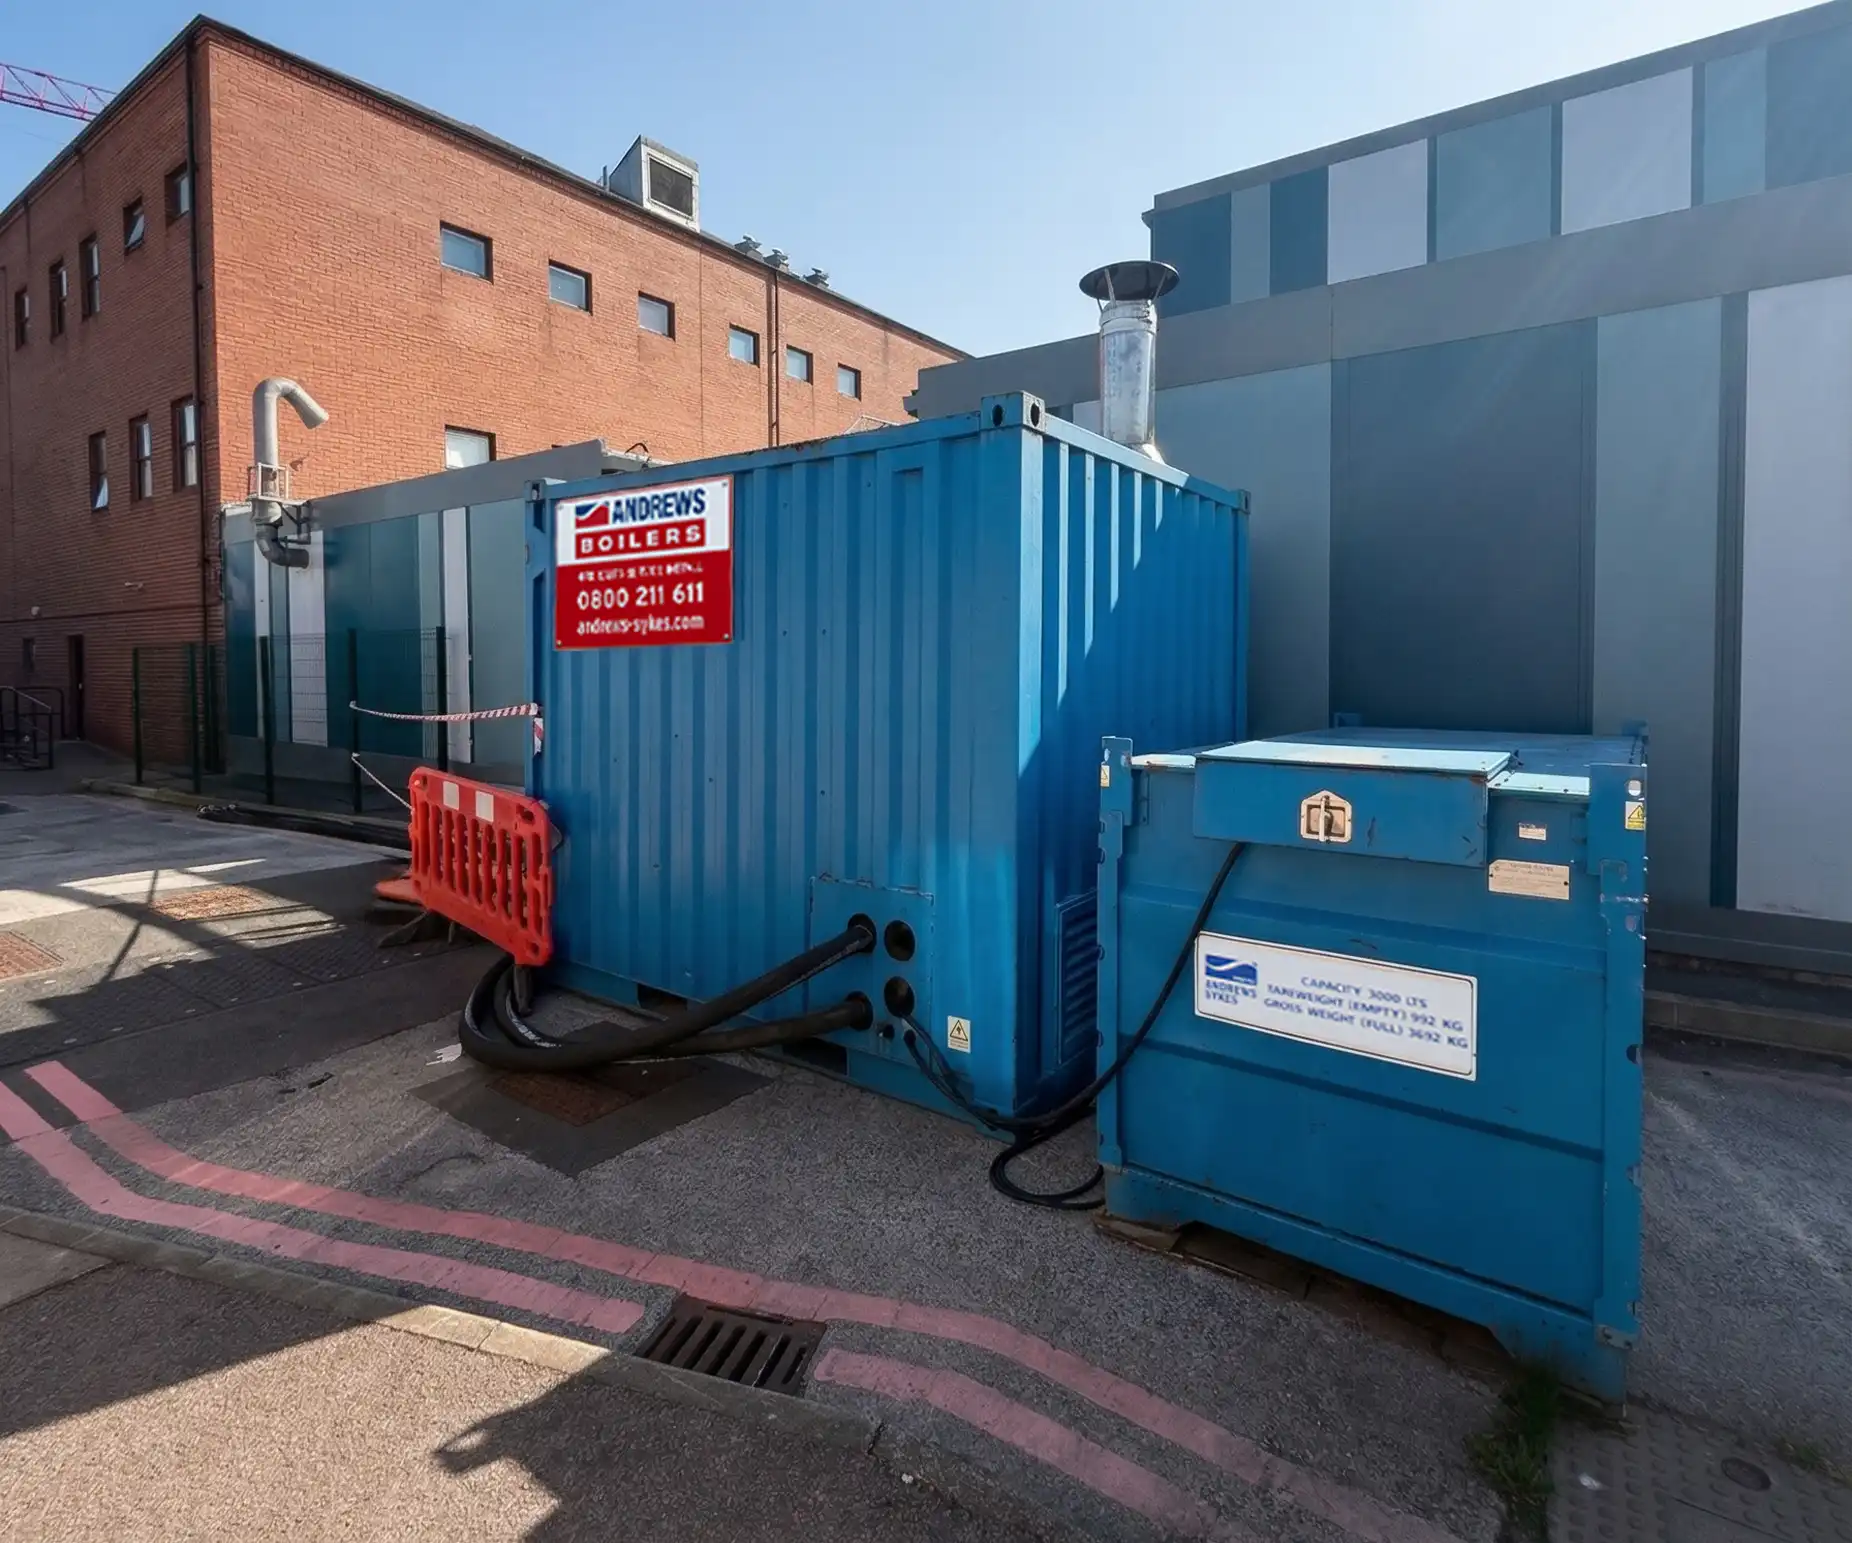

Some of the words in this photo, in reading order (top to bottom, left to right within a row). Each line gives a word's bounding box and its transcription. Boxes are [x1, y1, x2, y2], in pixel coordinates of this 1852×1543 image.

[612, 487, 706, 525] ANDREWS
[580, 524, 702, 554] BOILERS
[576, 588, 630, 611] 0800
[635, 585, 665, 607] 211
[672, 581, 704, 604] 611
[576, 614, 705, 636] andrews-sykes.com
[1300, 976, 1362, 996] CAPACITY
[1368, 988, 1402, 1004] 3000
[1406, 996, 1428, 1010] LTS
[1307, 1006, 1356, 1026] WEIGHT
[1408, 1027, 1441, 1043] 3692
[1446, 1034, 1468, 1049] KG
[1411, 1012, 1437, 1027] 992
[1442, 1018, 1464, 1032] KG
